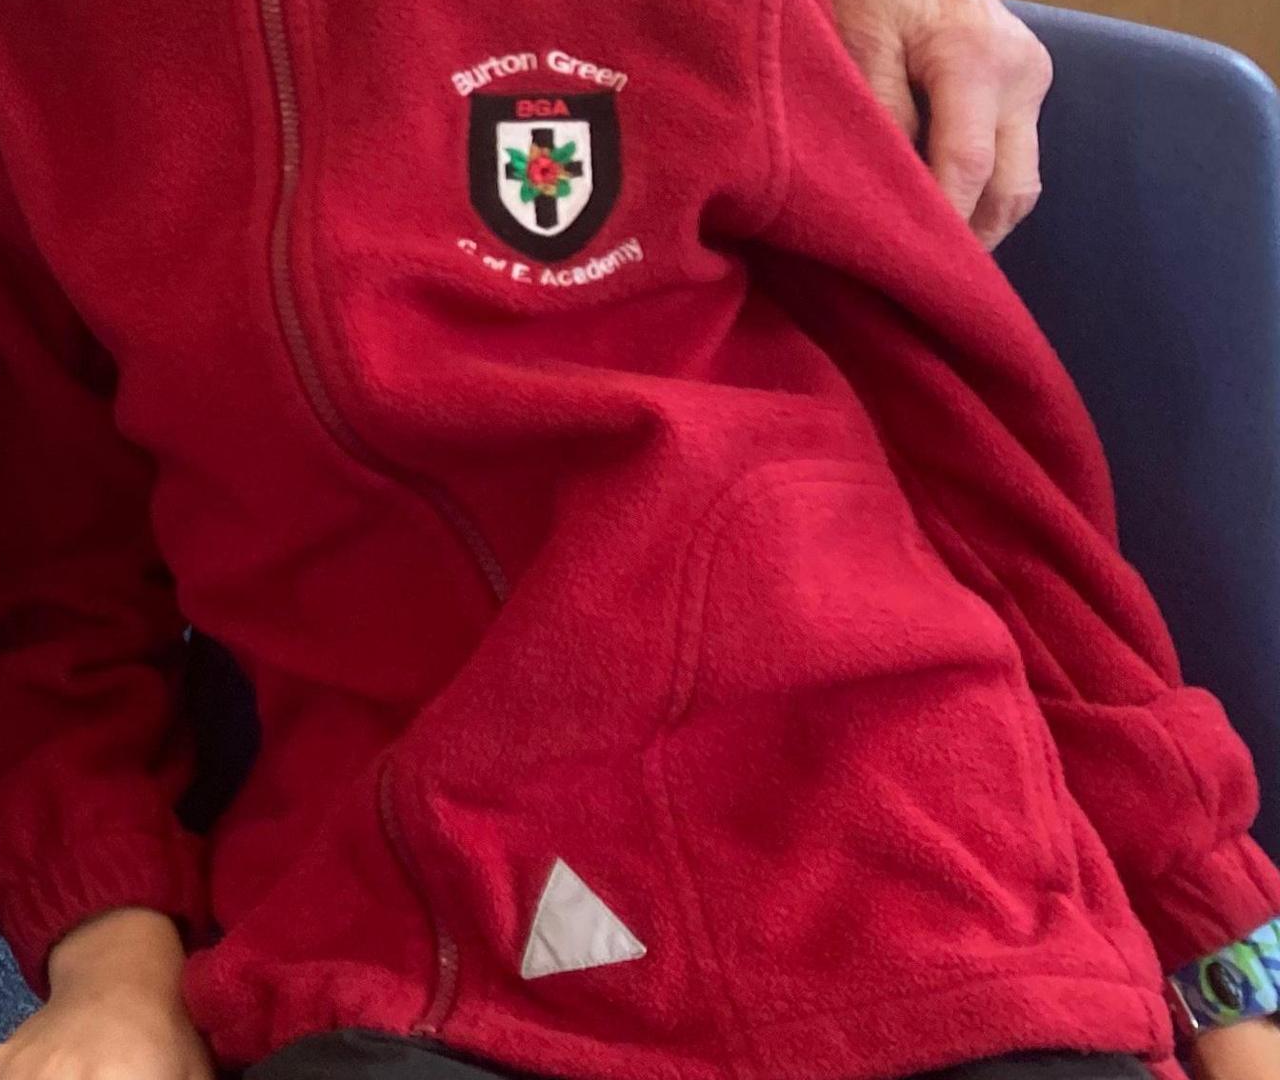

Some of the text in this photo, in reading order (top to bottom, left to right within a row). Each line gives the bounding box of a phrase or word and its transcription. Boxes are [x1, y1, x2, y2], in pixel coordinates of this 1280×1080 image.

[451, 50, 628, 96] Burton Green
[516, 99, 570, 118] BGA
[457, 238, 478, 255] C
[511, 263, 533, 284] E
[540, 237, 644, 286] Academy
